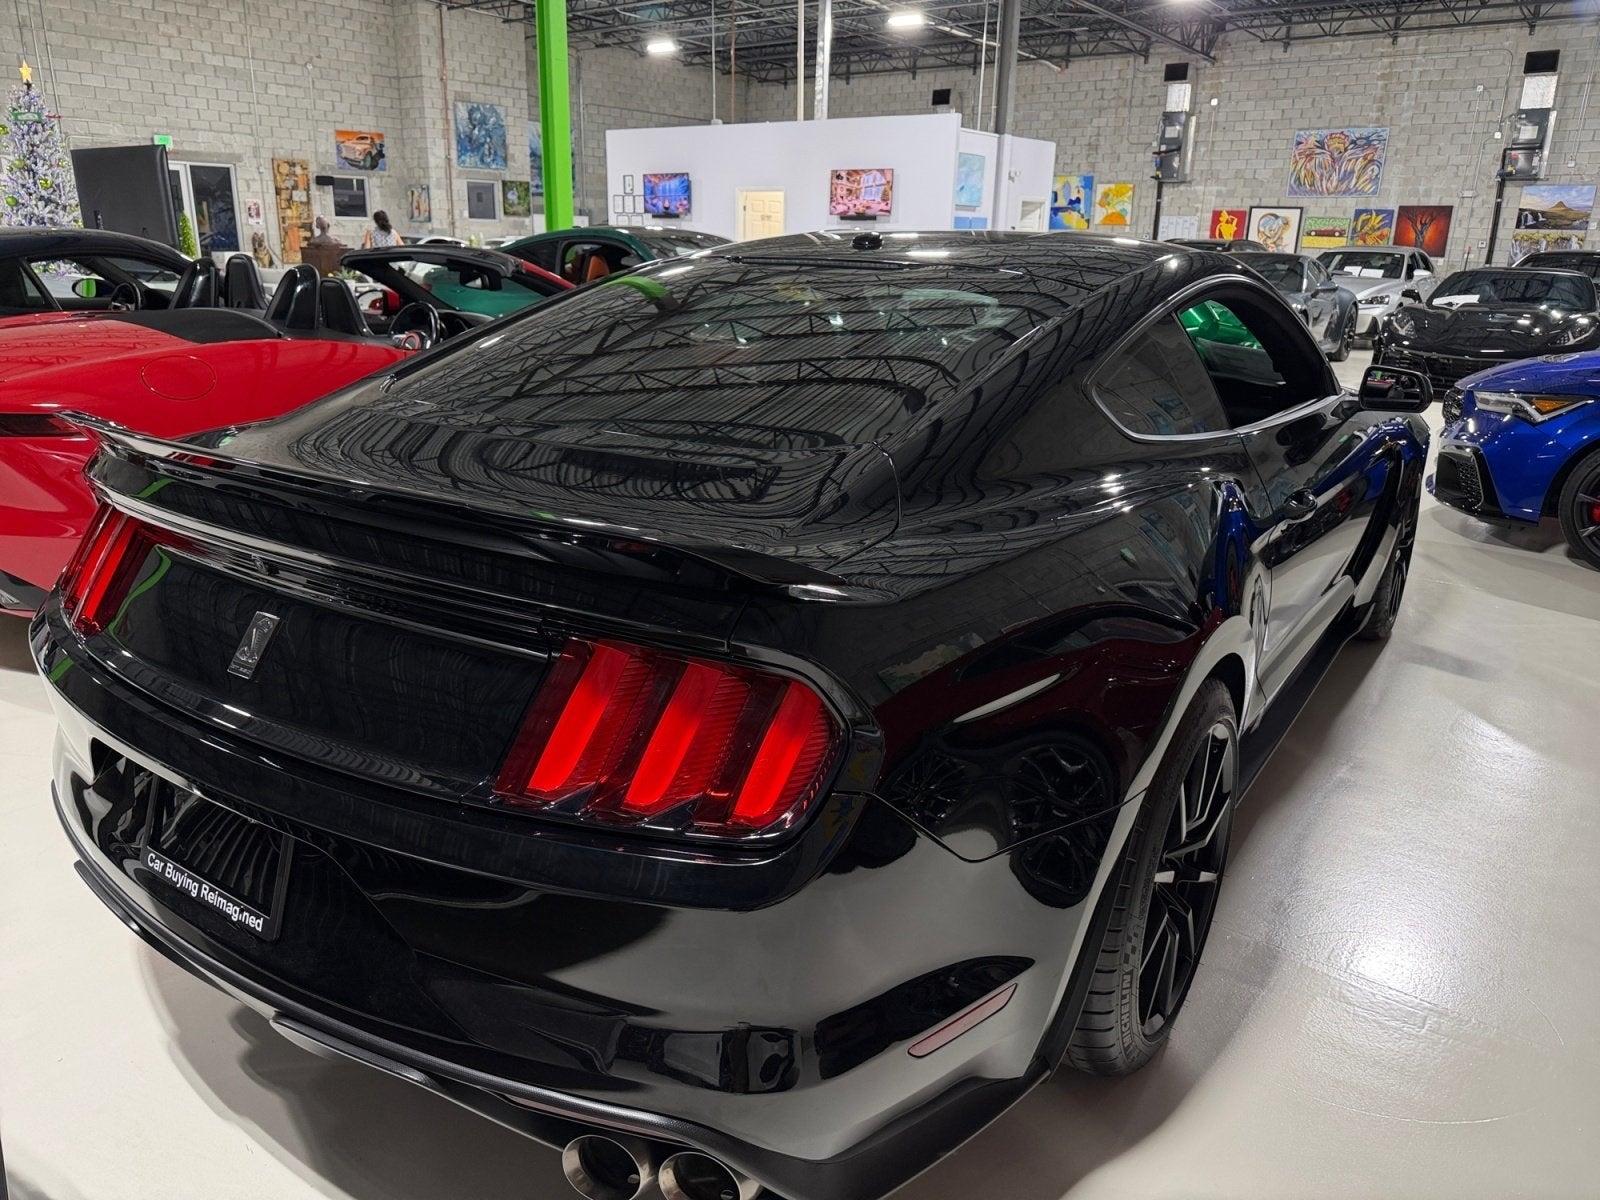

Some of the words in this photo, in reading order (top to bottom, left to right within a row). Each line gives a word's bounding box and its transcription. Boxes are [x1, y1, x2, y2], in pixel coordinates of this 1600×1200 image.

[147, 853, 165, 872] Car
[165, 863, 199, 897] Buying
[1121, 973, 1132, 1048] MICHELIN
